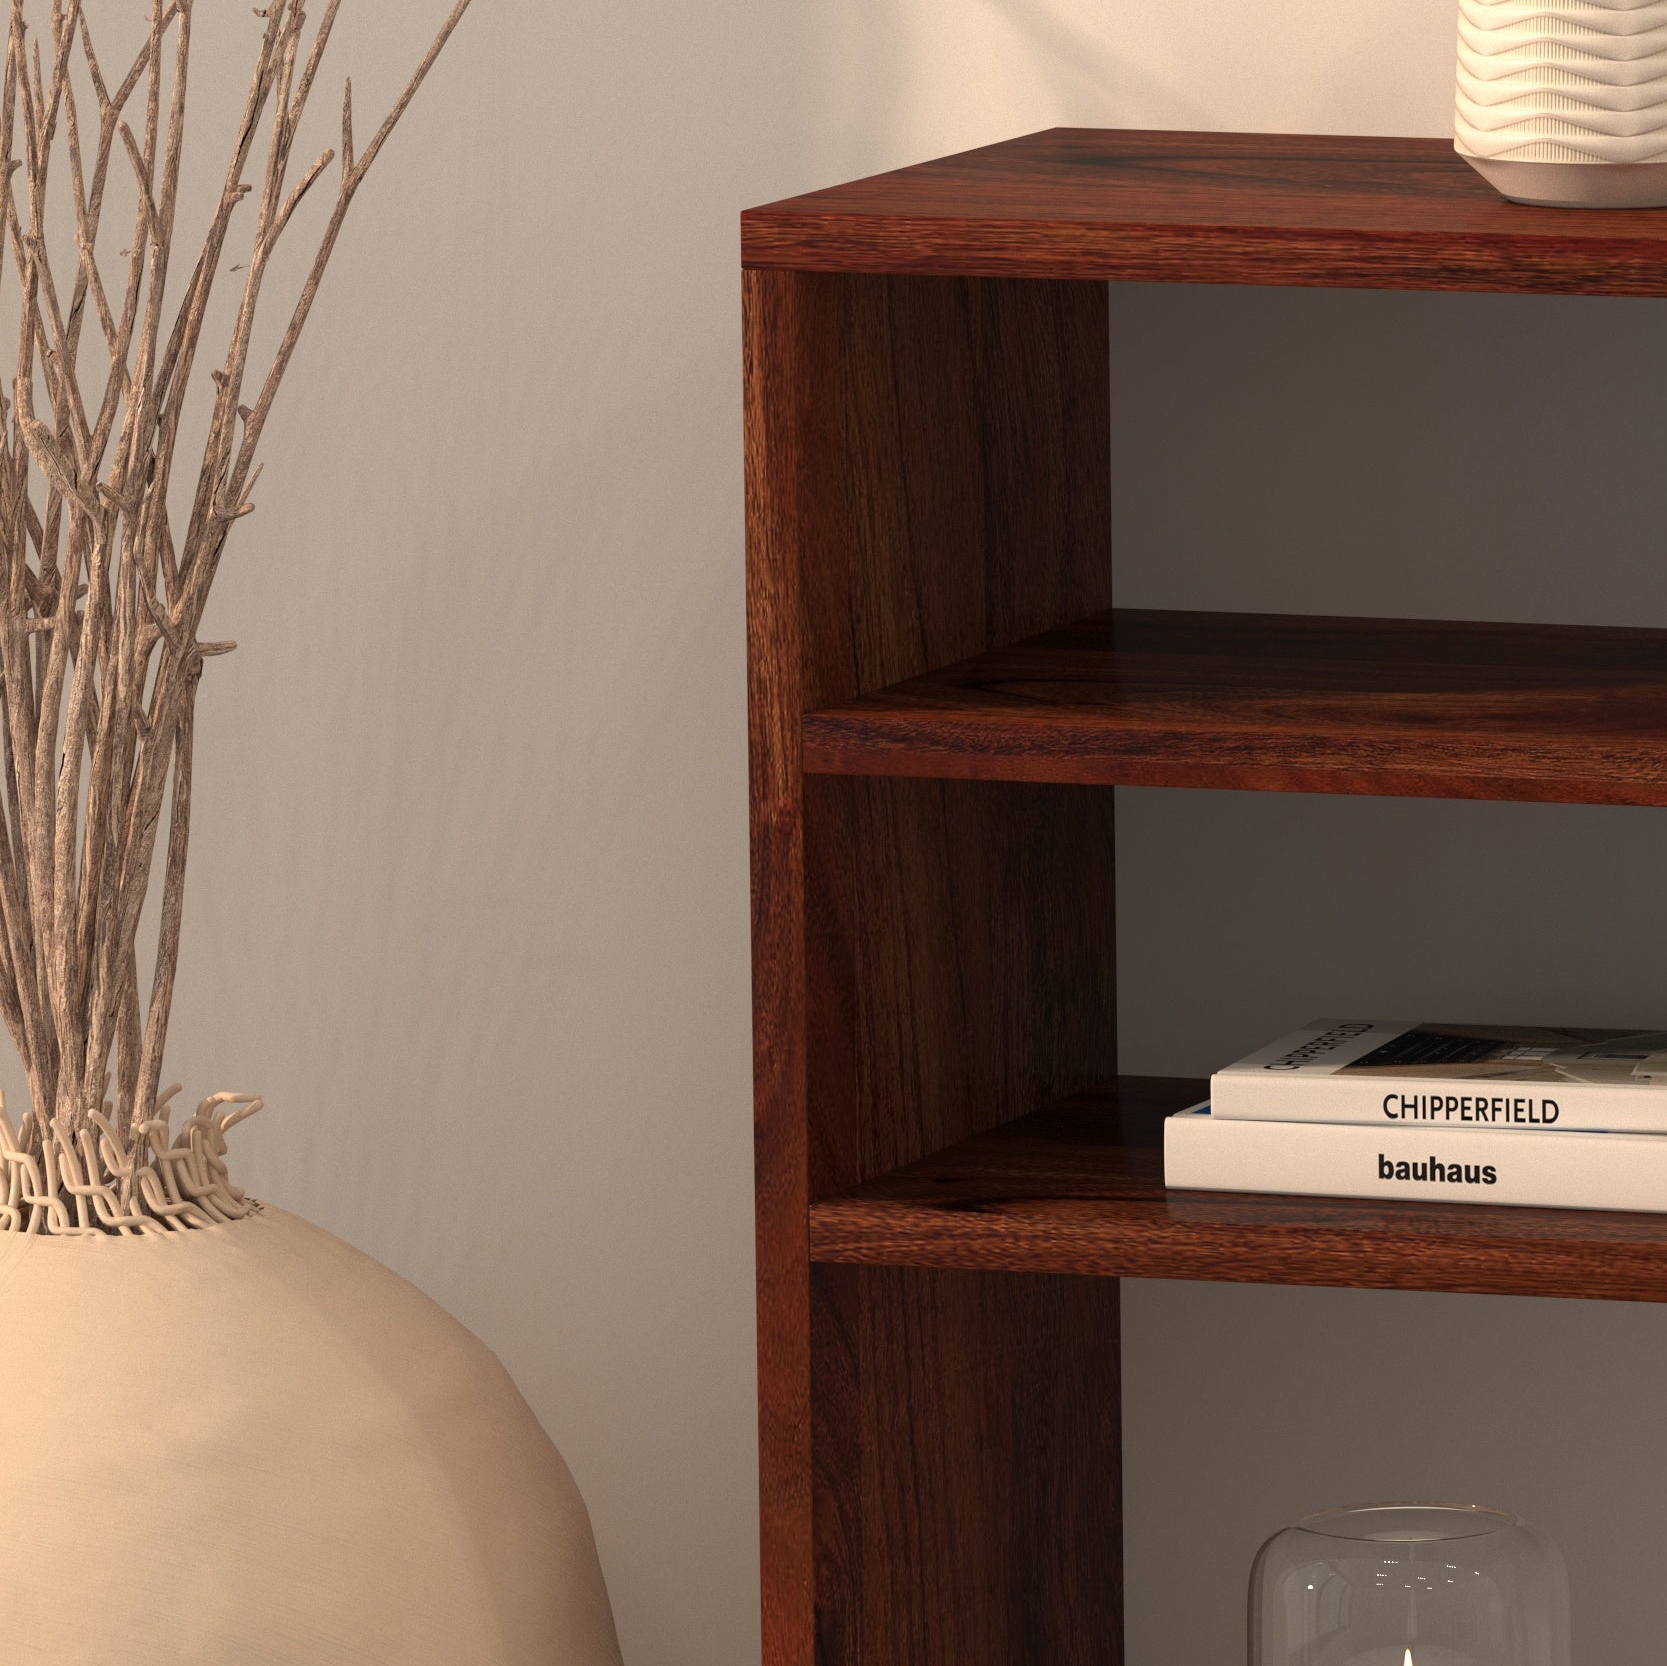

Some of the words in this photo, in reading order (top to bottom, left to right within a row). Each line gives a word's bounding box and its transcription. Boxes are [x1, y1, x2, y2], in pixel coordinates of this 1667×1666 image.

[1263, 1023, 1375, 1071] CHIPPERFIELD
[1382, 1093, 1560, 1124] CHIPPERFIELD
[1378, 1153, 1498, 1185] bauhaus
